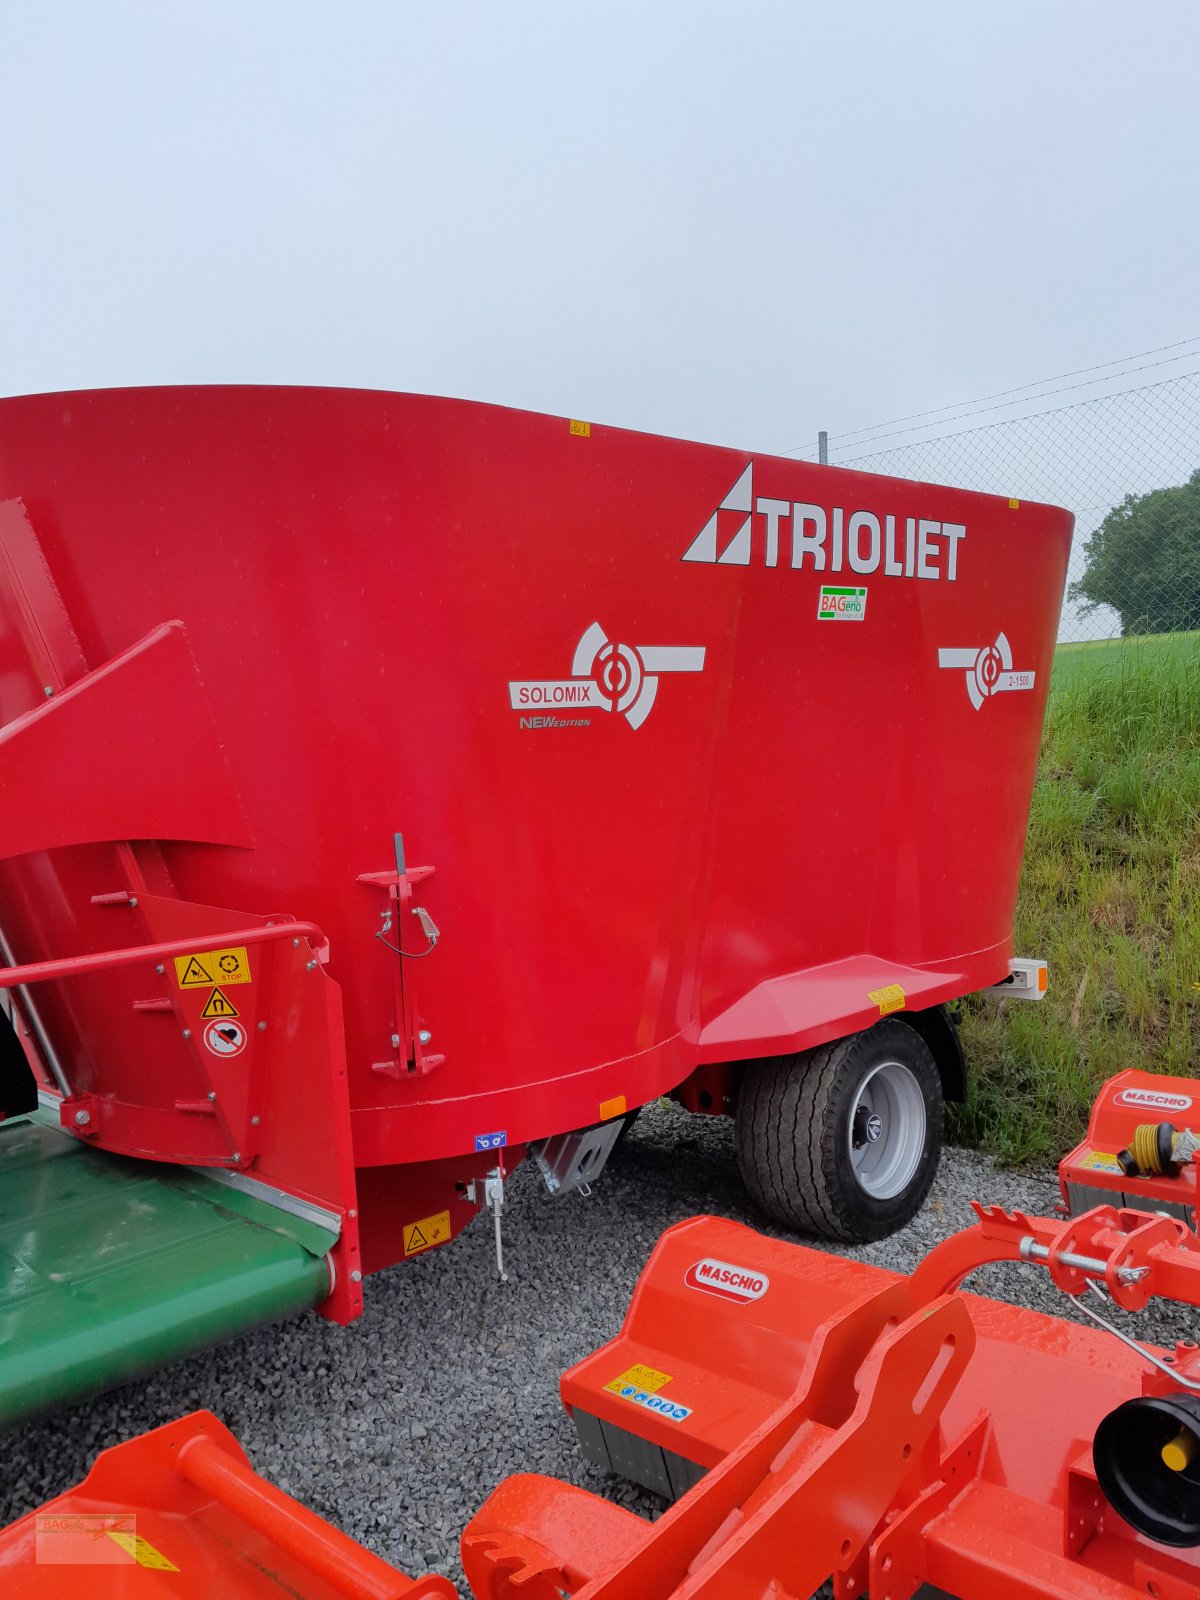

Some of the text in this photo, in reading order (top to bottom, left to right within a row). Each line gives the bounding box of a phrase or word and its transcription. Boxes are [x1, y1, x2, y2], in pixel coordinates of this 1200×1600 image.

[756, 496, 967, 581] TRIOLIET
[821, 595, 862, 612] BAGeno
[1008, 675, 1030, 687] 2-1500
[519, 686, 591, 704] SOLOMIX
[221, 973, 242, 981] STOP
[1125, 1092, 1188, 1107] MASCHIO
[699, 1264, 764, 1293] MASCHIO
